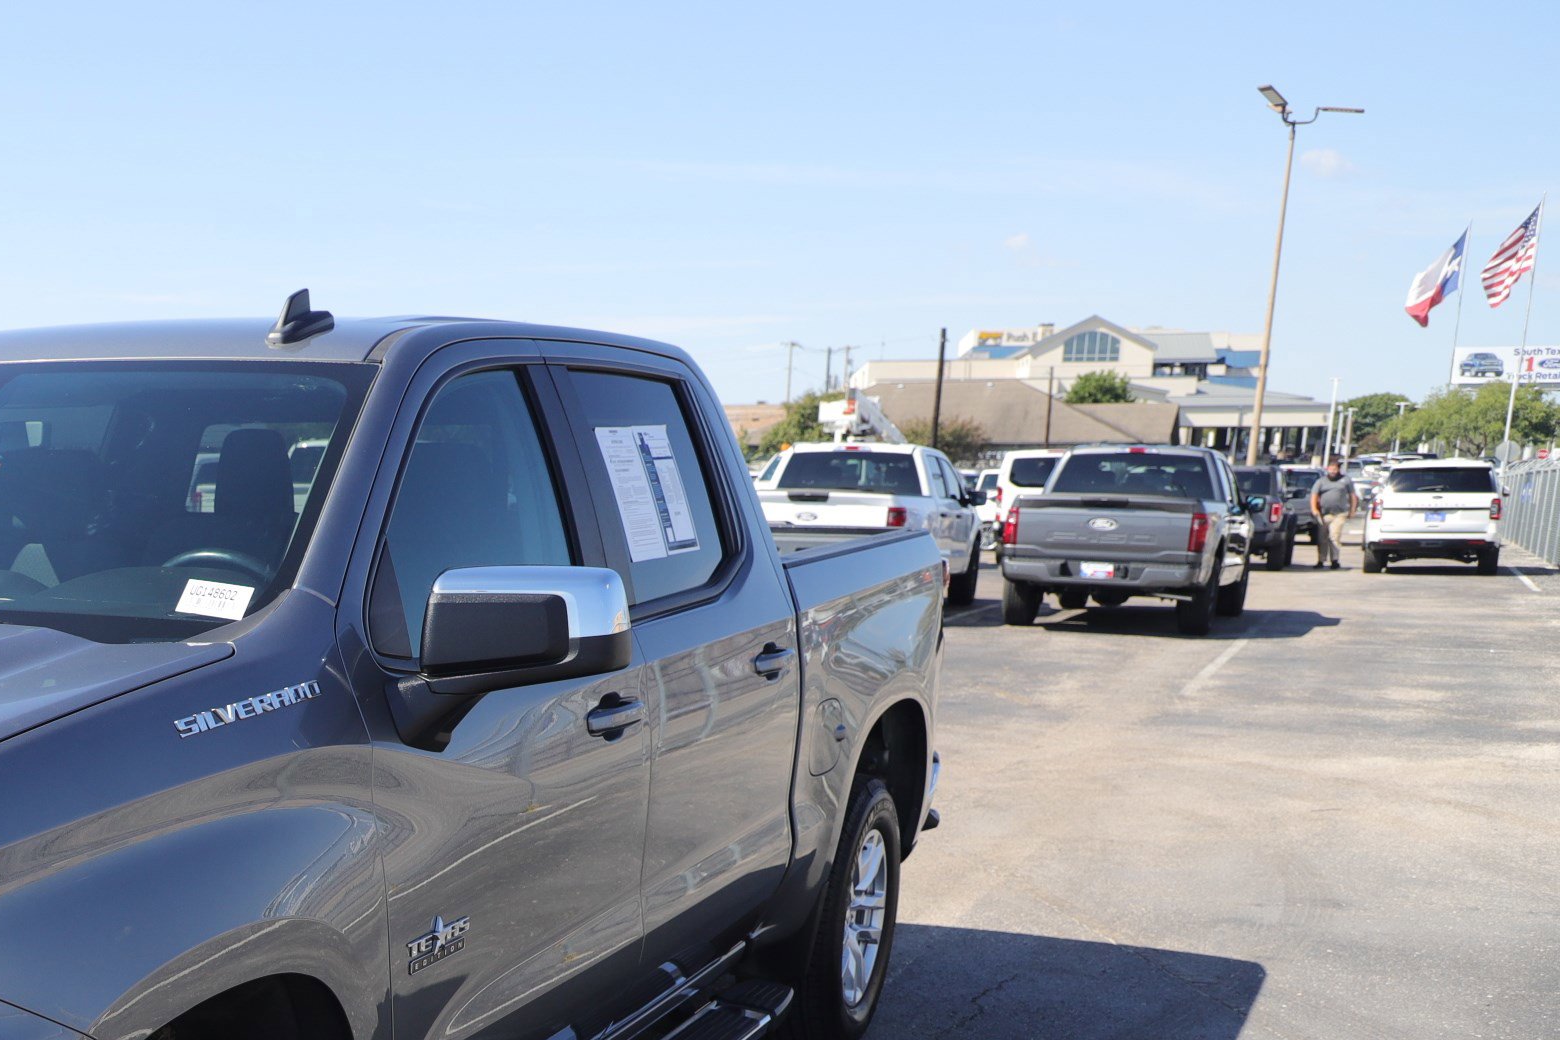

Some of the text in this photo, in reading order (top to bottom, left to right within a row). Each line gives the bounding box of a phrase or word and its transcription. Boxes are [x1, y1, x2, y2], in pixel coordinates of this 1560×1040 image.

[1525, 356, 1534, 372] 1
[189, 585, 238, 601] UG148602
[173, 679, 322, 739] SILVERADO
[406, 915, 470, 957] TEXAS
[414, 941, 464, 971] EDITION
